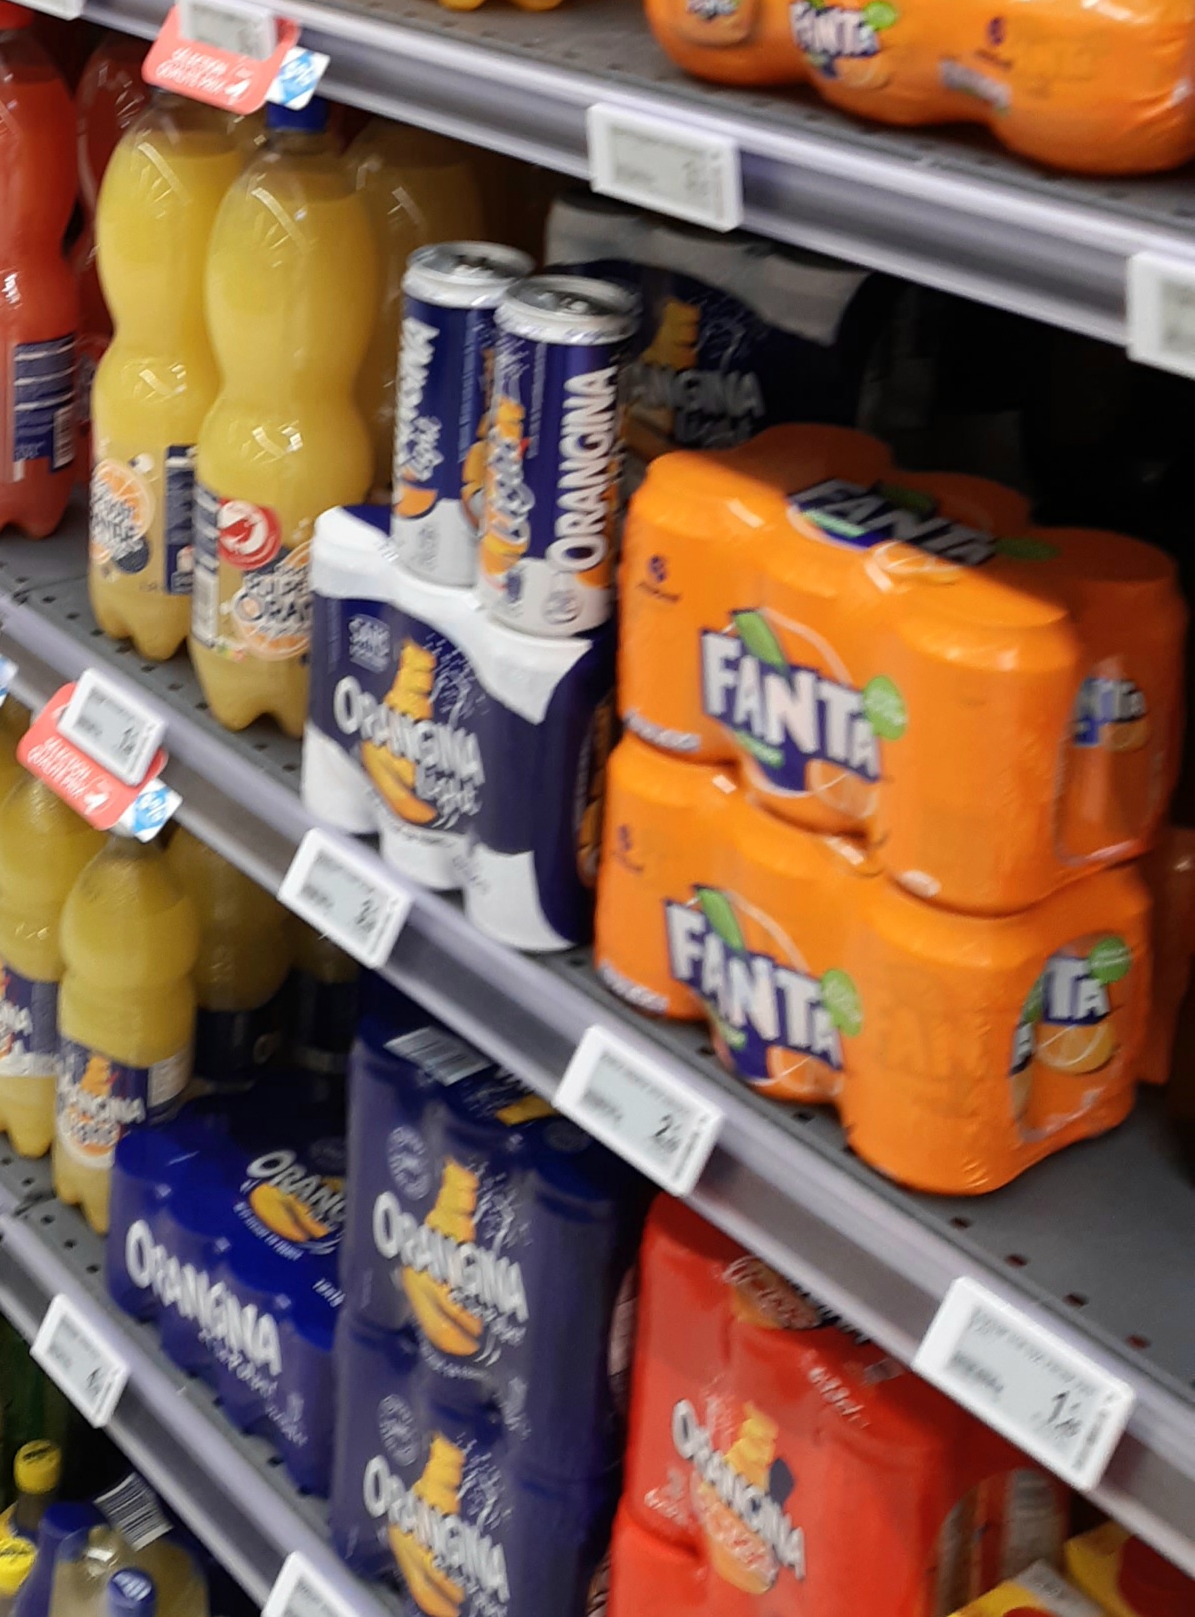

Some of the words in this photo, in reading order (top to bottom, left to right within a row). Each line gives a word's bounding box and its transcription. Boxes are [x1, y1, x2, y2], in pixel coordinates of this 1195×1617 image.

[546, 364, 621, 578] ORANGINA
[787, 478, 996, 566] FANTA
[333, 674, 486, 785] ORANGINA
[700, 632, 880, 779] FANTA
[666, 902, 846, 1069] FANTA
[245, 1149, 347, 1229] ORANG
[372, 1190, 530, 1325] ORANGINA
[124, 1219, 283, 1377] ORANGINA
[363, 1454, 511, 1605] ORANGINA
[671, 1397, 806, 1582] ORANGINA
